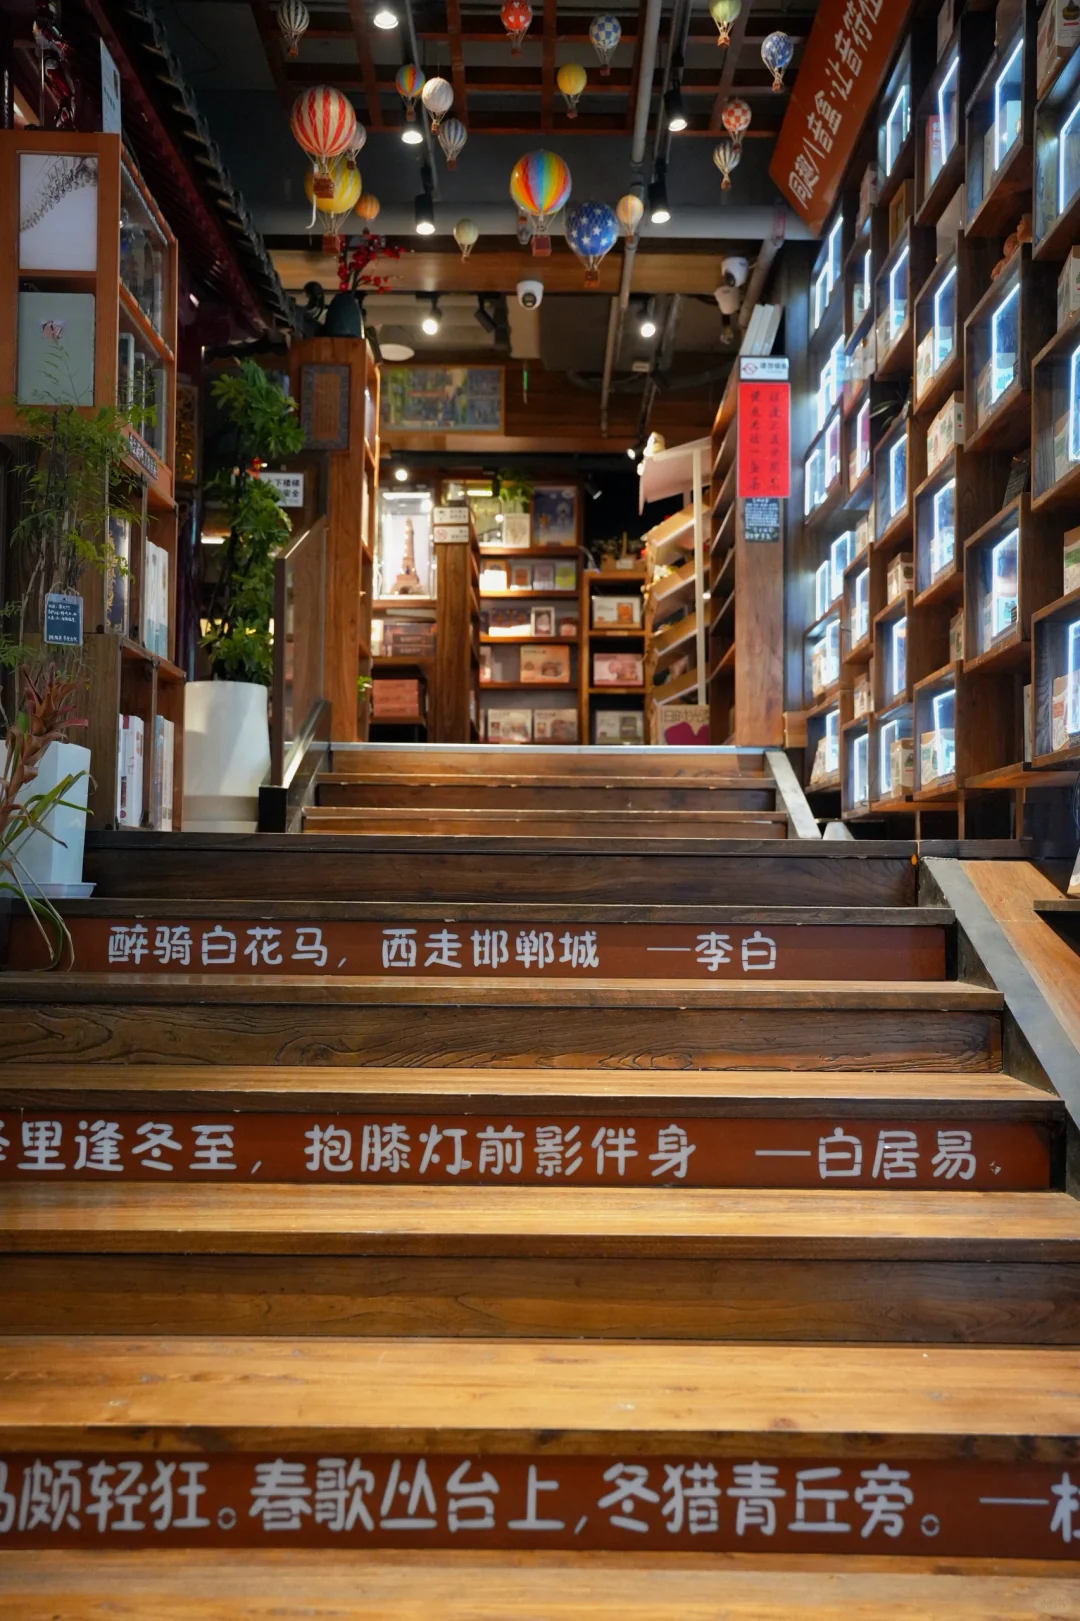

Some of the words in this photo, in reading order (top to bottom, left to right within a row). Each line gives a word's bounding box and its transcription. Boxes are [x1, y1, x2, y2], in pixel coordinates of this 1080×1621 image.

[0, 1121, 697, 1177] 里逢冬至，抱膝灯前影伴身
[0, 1460, 938, 1538] 颇轻狂。春歌丛台上，冬猎青丘旁。
